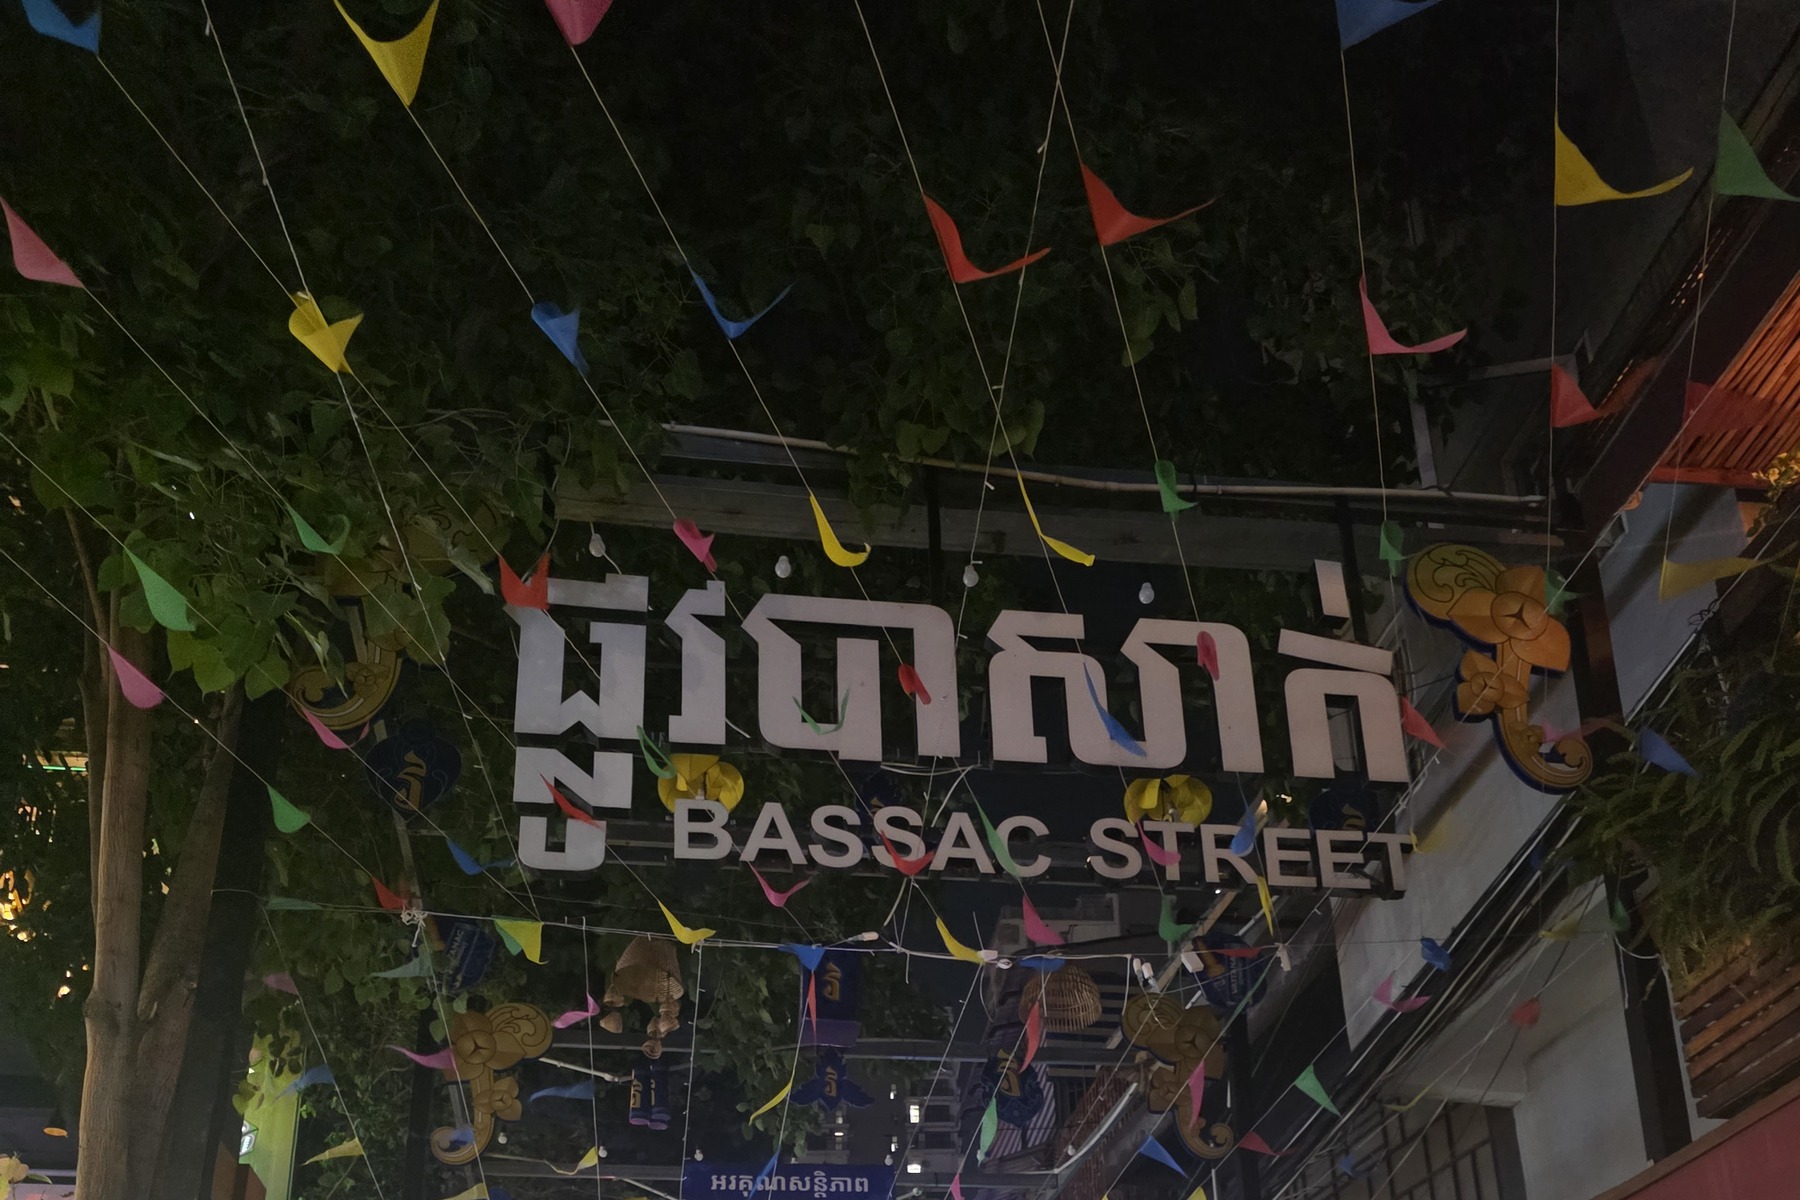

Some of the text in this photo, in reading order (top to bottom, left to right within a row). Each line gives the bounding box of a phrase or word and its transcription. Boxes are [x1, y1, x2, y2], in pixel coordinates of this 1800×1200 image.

[674, 799, 1416, 893] BASSAC STREET
[710, 1170, 869, 1199] អរគុណសន្តិភាព
